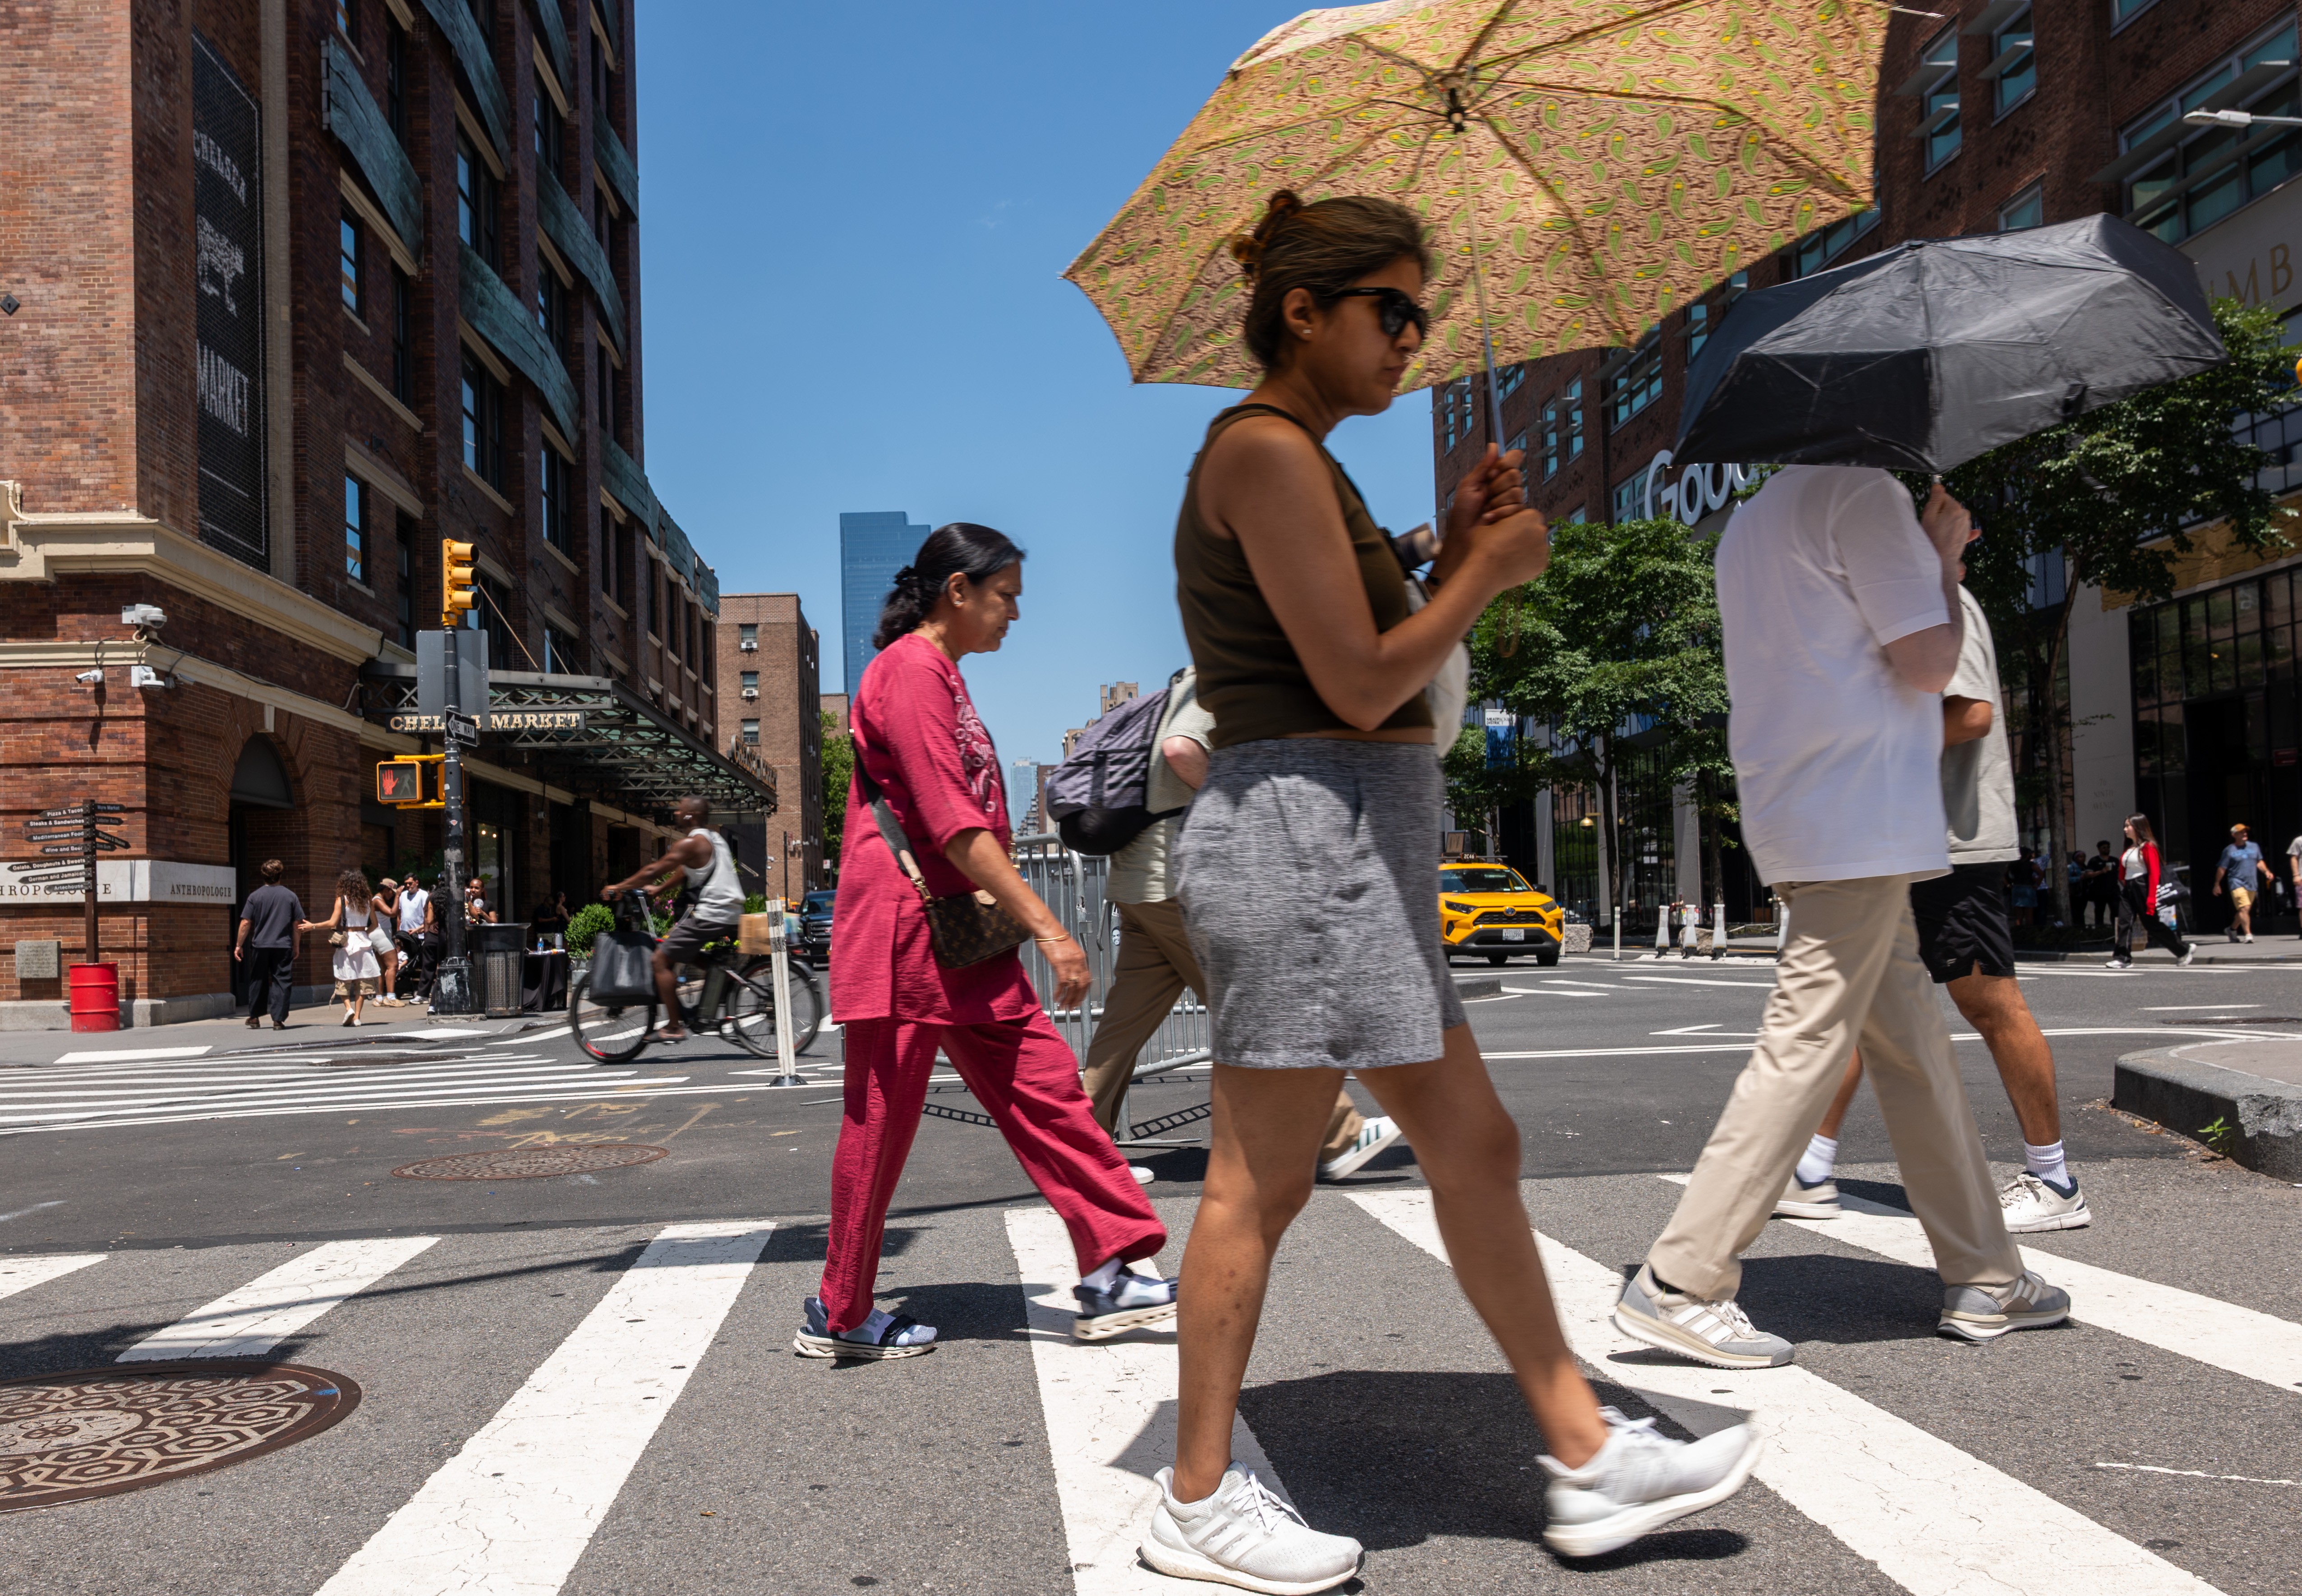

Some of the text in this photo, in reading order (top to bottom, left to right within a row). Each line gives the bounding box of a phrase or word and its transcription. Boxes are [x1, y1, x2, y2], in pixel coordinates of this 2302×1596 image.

[193, 129, 246, 207] CHELSEA
[197, 339, 248, 437] MARKET
[451, 720, 473, 736] ONE WAY
[490, 713, 580, 729] MARKET
[13, 862, 32, 870] Gelato,
[33, 860, 60, 869] Doughnuts
[170, 884, 231, 897] ANTHROPOLOGIE
